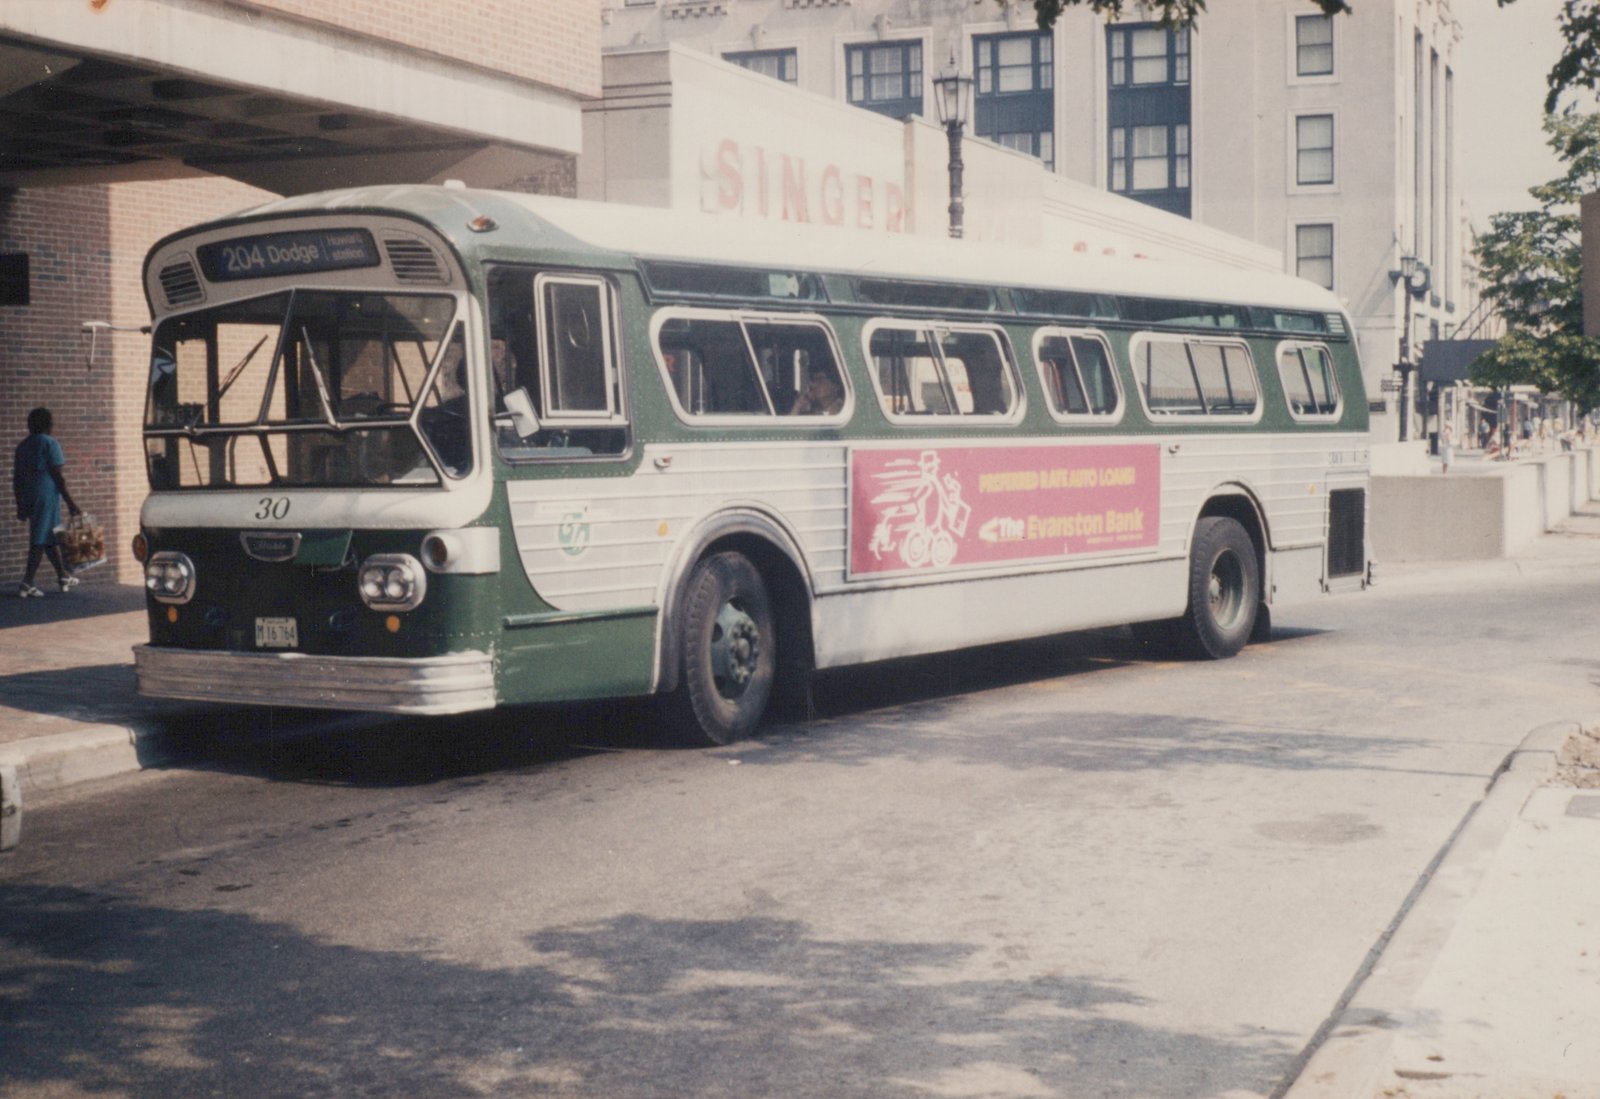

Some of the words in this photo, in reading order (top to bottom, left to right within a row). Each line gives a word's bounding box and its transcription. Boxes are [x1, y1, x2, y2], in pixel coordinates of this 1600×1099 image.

[717, 138, 904, 233] SINGER
[223, 244, 265, 272] 204
[267, 241, 320, 265] Dodge
[255, 497, 291, 520] 30
[1000, 517, 1025, 538] The
[1027, 512, 1104, 541] Evanston
[1106, 507, 1144, 534] Bank
